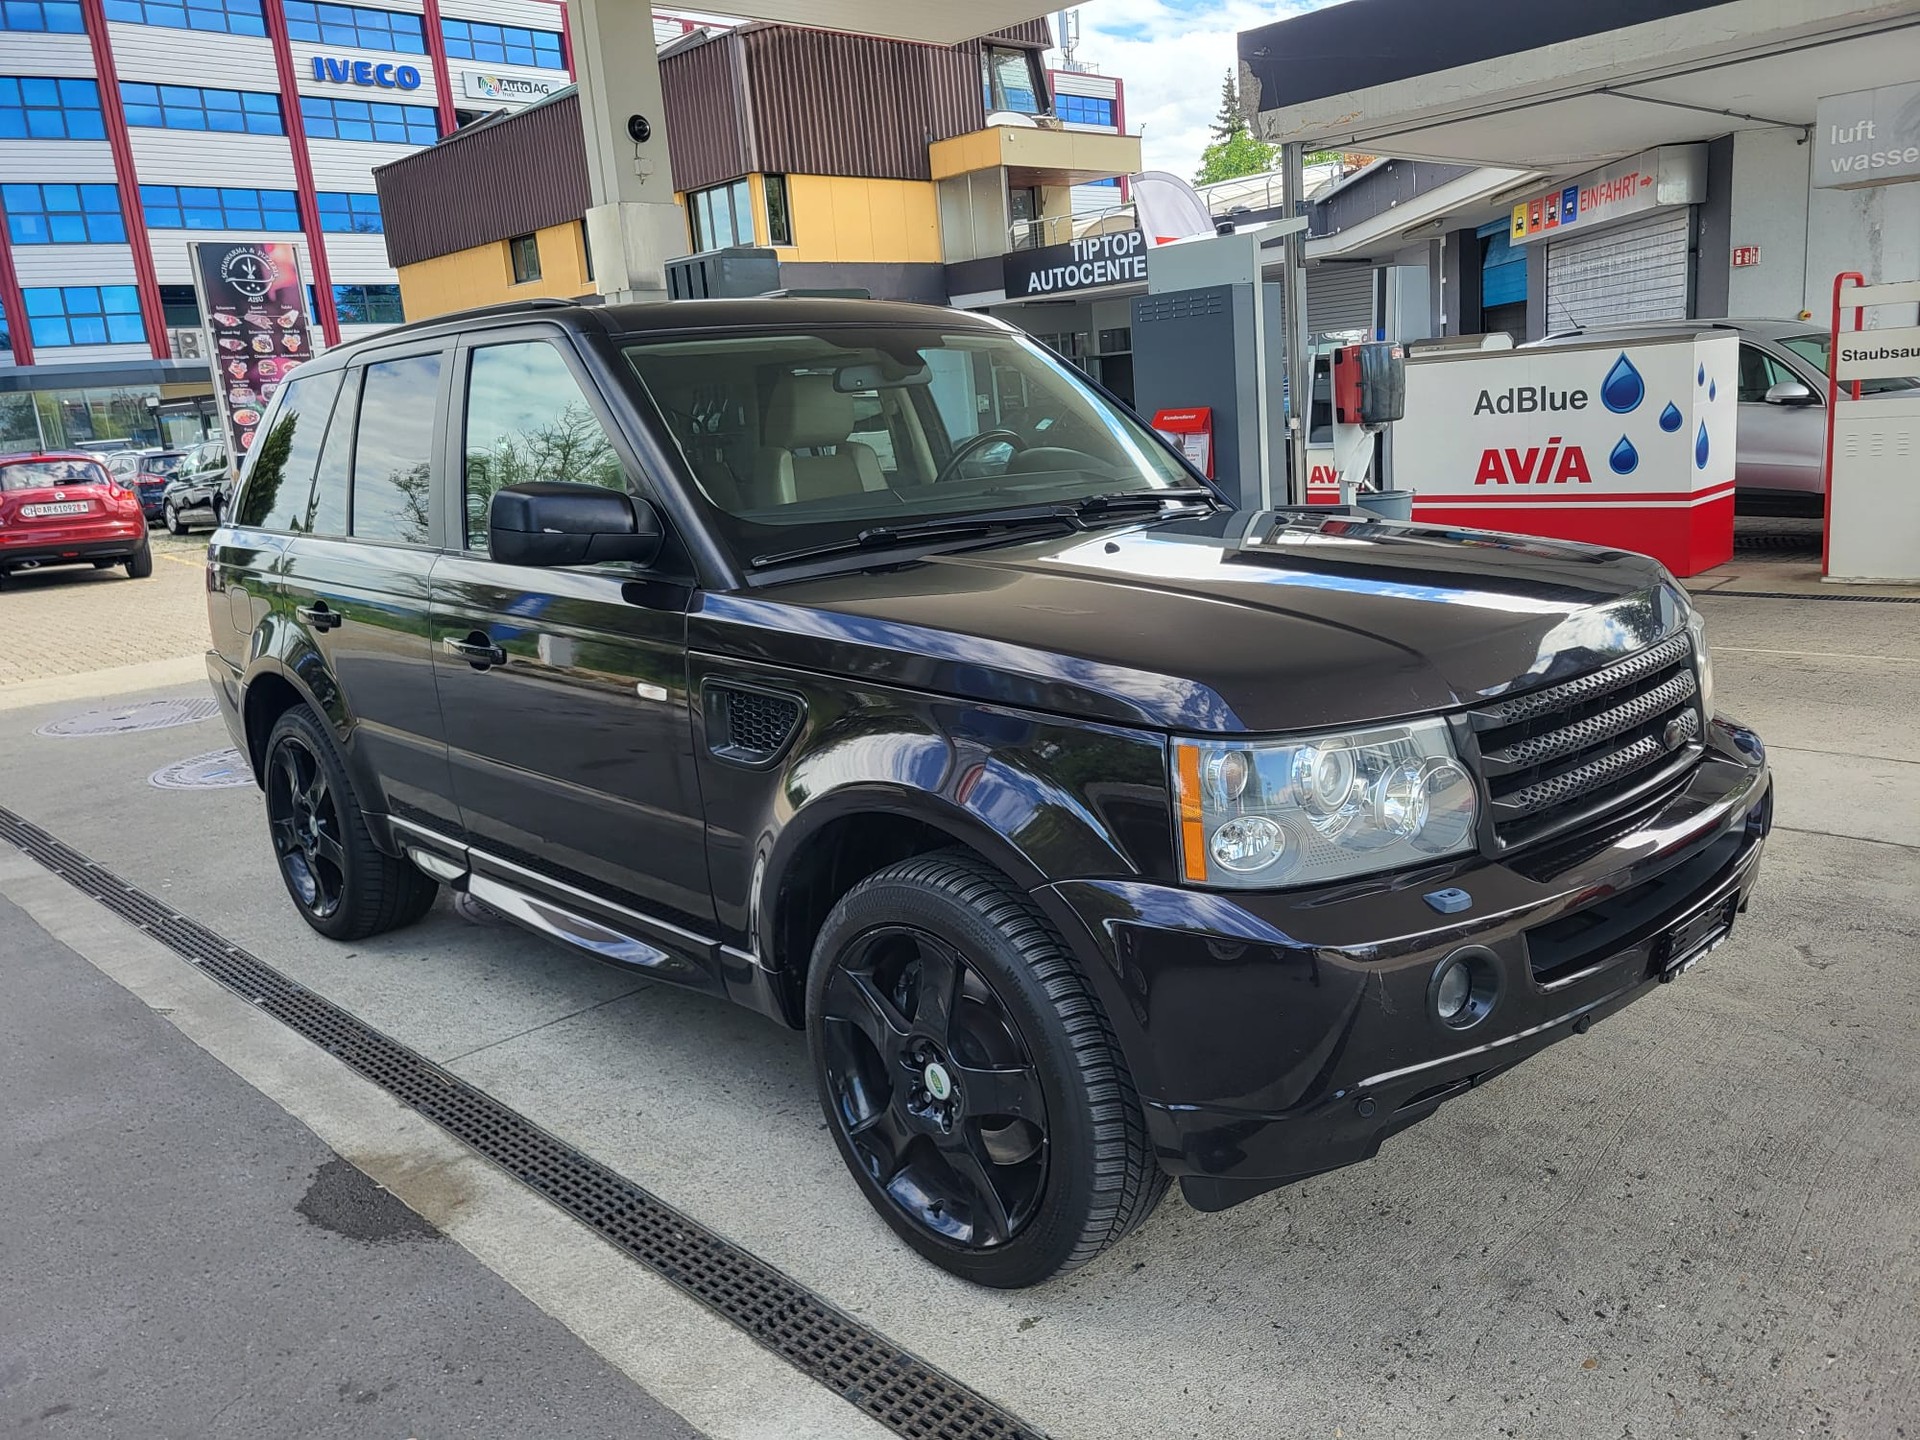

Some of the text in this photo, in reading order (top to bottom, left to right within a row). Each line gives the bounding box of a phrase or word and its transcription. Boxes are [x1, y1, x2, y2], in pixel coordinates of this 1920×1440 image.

[313, 56, 421, 90] IVECO
[501, 80, 549, 94] Auto AG
[1831, 120, 1876, 145] luft
[1830, 147, 1920, 173] wasse
[1580, 172, 1639, 212] EINFAHRT
[1070, 231, 1141, 262] TIPTOP
[1028, 255, 1147, 293] AUTOCENTE
[1841, 347, 1920, 362] Staubsau
[1473, 385, 1588, 416] AdBlue
[1310, 465, 1340, 484] AV
[1474, 436, 1592, 485] AVIA
